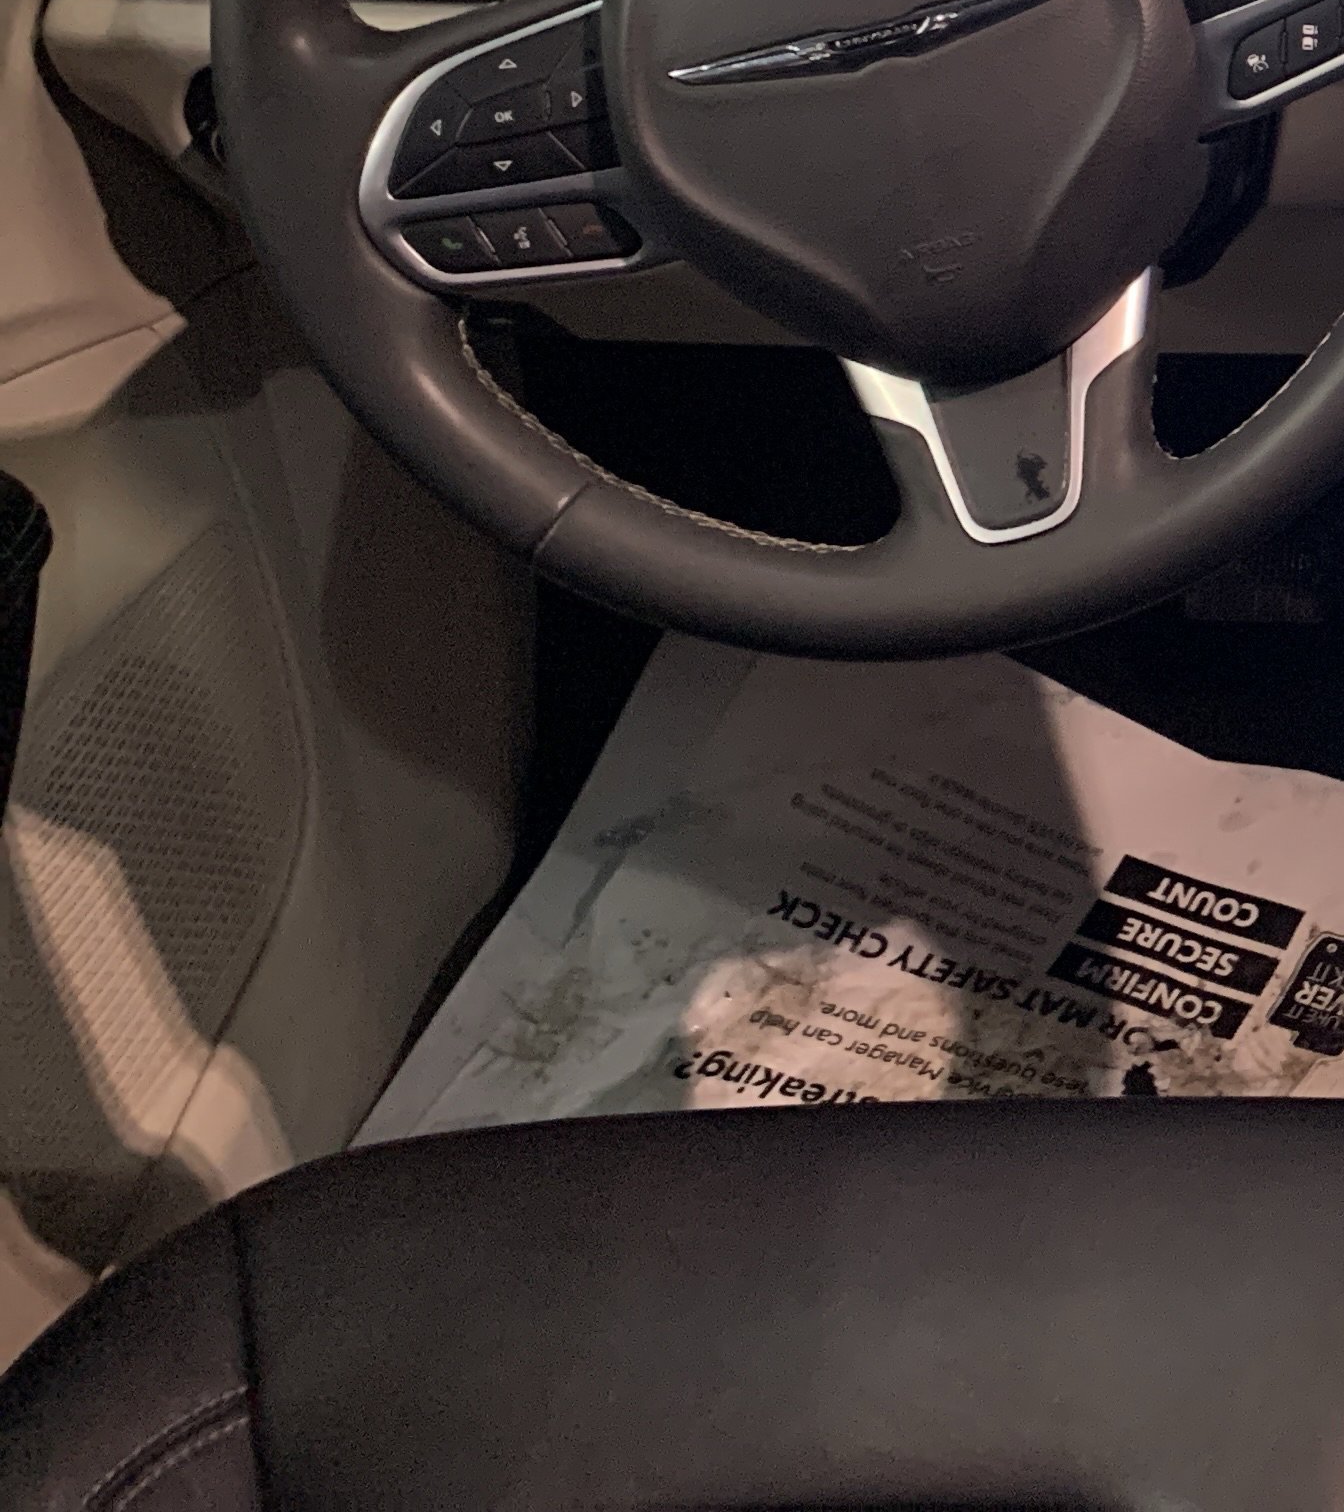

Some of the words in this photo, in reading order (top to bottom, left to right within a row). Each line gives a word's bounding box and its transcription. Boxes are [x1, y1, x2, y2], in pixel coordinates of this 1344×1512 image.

[494, 109, 513, 124] OK
[766, 889, 887, 958] CHECK
[1147, 878, 1259, 927] COUNT
[1117, 918, 1238, 976] SECURE
[1306, 962, 1330, 982] IT
[887, 945, 1020, 1011] SAFETY
[1076, 958, 1223, 1026] CONFIRM
[1011, 981, 1096, 1034] MAT
[1282, 1004, 1304, 1019] IT
[799, 1019, 845, 1052] can
[842, 1030, 944, 1085] Manager
[878, 1017, 926, 1051] and
